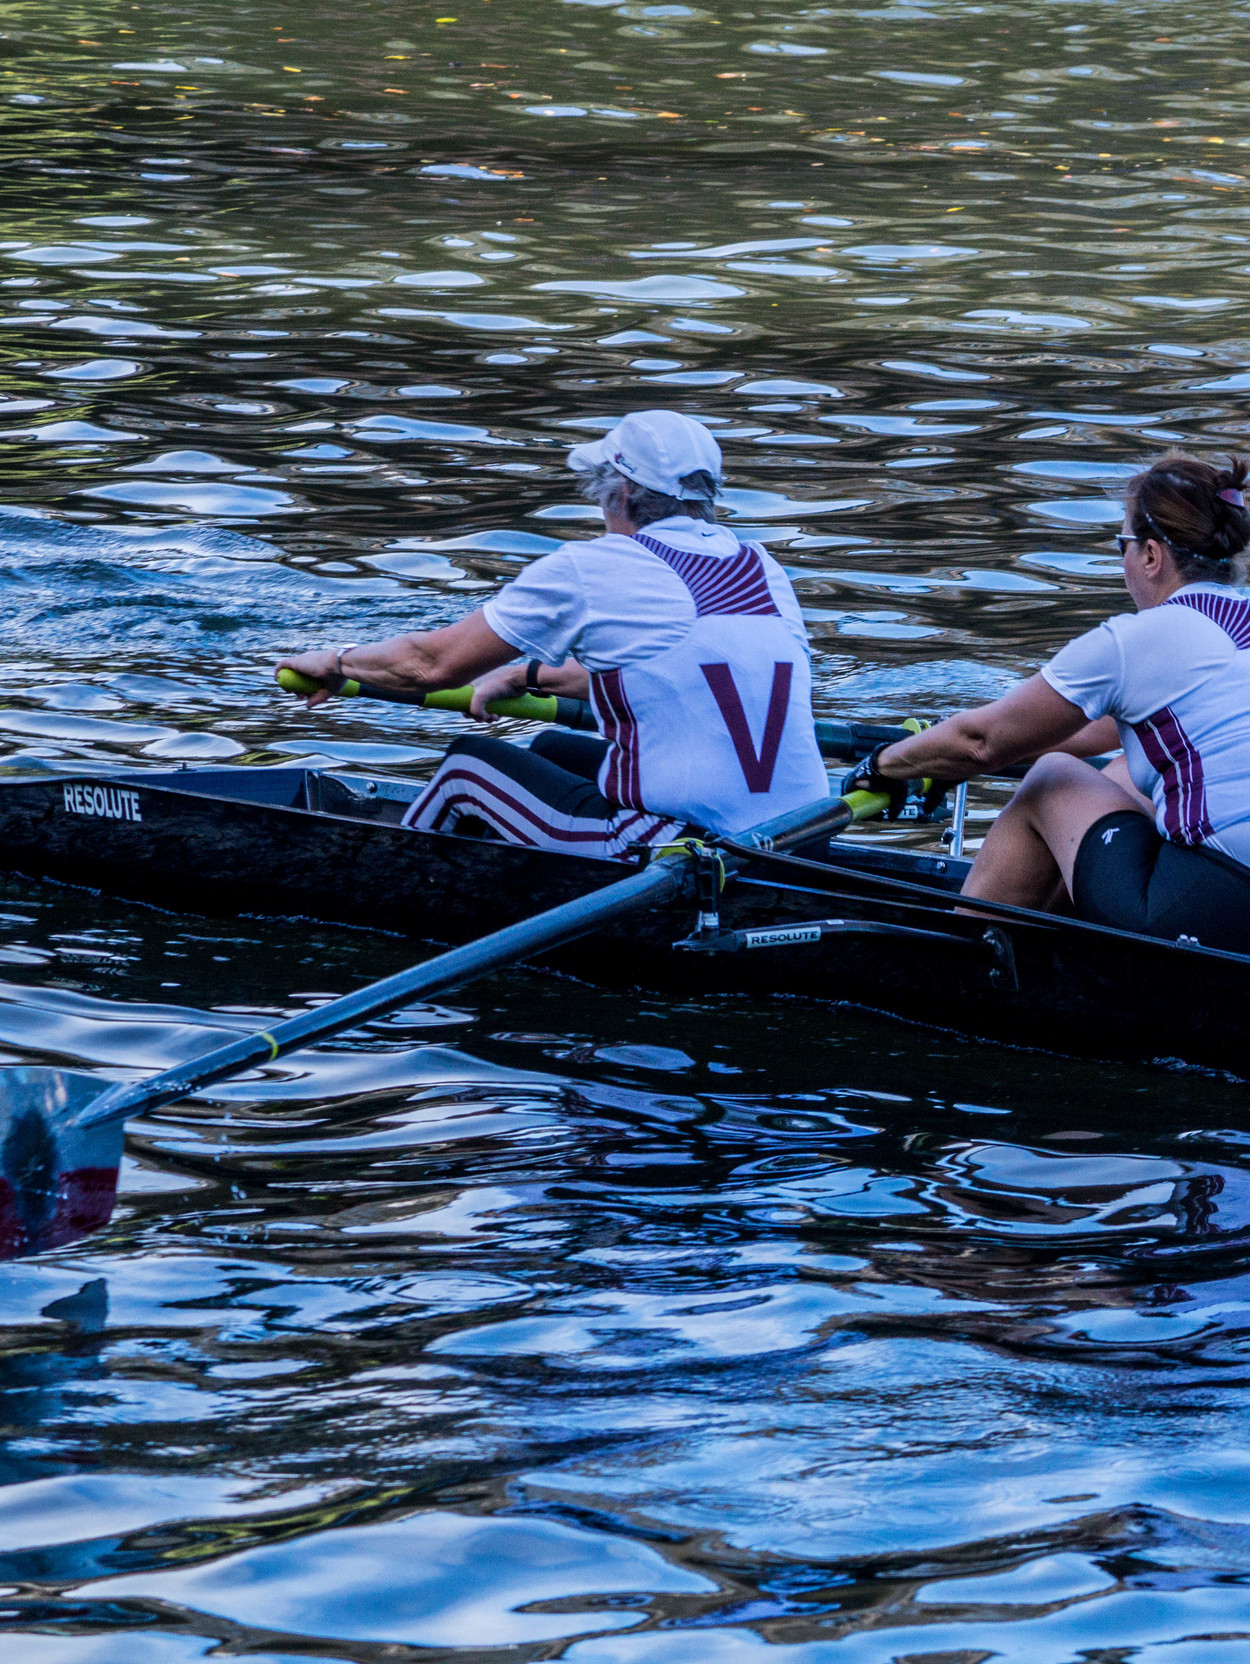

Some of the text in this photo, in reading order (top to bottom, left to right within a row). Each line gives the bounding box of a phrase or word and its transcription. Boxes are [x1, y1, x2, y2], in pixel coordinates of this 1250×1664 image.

[700, 662, 793, 794] V
[63, 783, 142, 822] RESOLUTE
[751, 930, 819, 945] RESOLUTE
